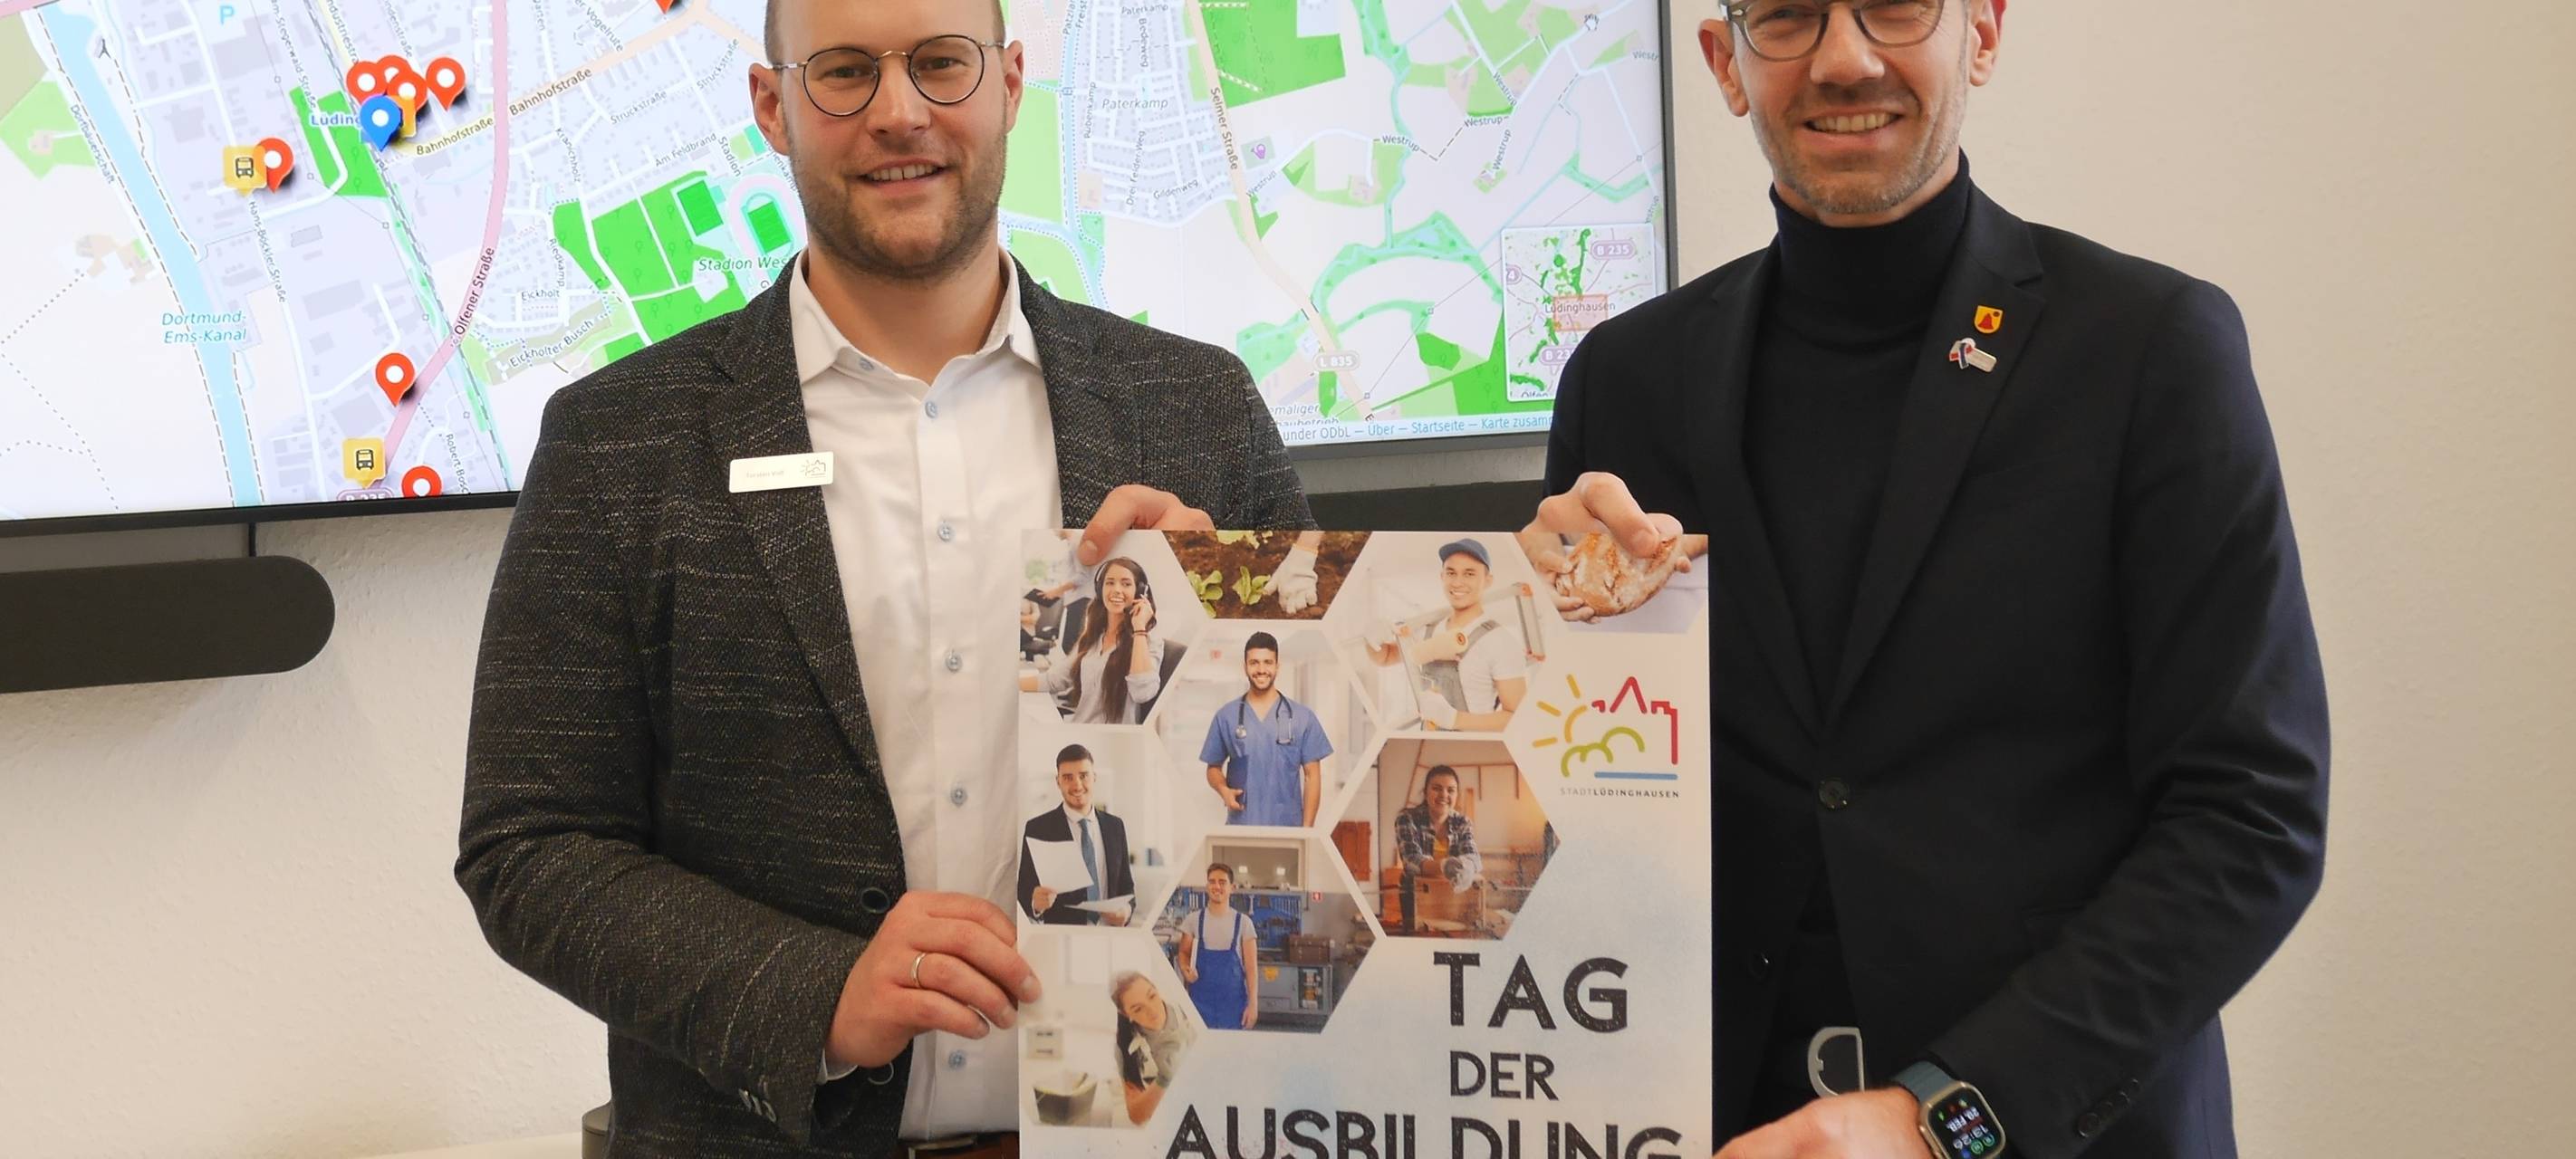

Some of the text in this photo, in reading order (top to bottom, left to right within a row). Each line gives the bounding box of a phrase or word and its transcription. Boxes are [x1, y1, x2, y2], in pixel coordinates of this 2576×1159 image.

[586, 7, 624, 52] Vogelrute
[696, 38, 739, 91] Struckstraße
[509, 68, 593, 116] Bahnhofstraße
[1101, 98, 1169, 110] Paterkamp
[1493, 72, 1517, 107] Westrup
[610, 90, 668, 125] Struckstraße
[1464, 116, 1503, 129] Westrup
[416, 117, 494, 157] Bahnhofstraße
[1210, 87, 1239, 170] Selmer Straße
[1381, 135, 1420, 153] Westrup
[655, 133, 717, 168] Am Feldbrand
[717, 136, 742, 177] Stadion
[1492, 129, 1512, 170] Westrup
[1152, 178, 1199, 200] Gildenweg
[1245, 169, 1277, 198] Westrup
[698, 257, 754, 271] Stadion
[1596, 244, 1630, 255] B 235
[472, 247, 495, 289] Straße
[1544, 300, 1616, 314] Lüdinghausen
[562, 319, 594, 346] Busch
[1330, 354, 1354, 368] 835
[1283, 427, 1317, 442] under
[1320, 426, 1351, 440] ODbL
[1368, 422, 1395, 436] Über
[1411, 419, 1465, 434] Startseite
[1481, 416, 1510, 430] Karte
[1433, 951, 1629, 1034] TAG
[1450, 1050, 1559, 1101] DER
[1162, 1104, 1683, 1159] AUSBILDUNG
